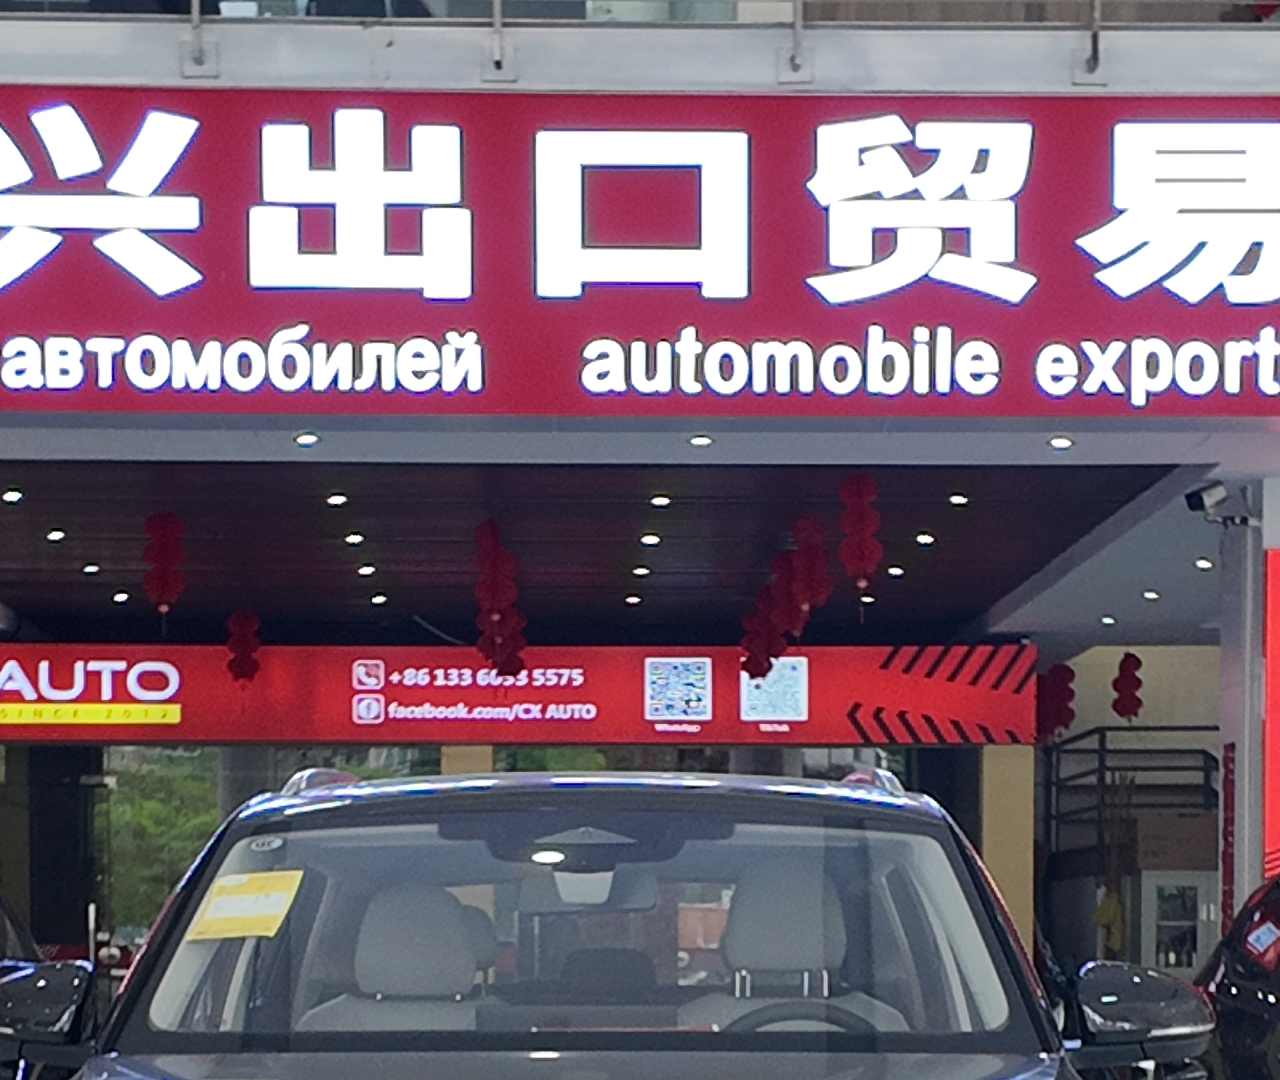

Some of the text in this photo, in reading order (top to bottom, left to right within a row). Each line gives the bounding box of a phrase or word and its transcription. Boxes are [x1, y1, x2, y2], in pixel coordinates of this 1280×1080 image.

[0, 322, 485, 394] автомобилей
[579, 323, 1002, 397] automobile
[388, 667, 431, 687] +86
[433, 668, 473, 687] 133
[531, 668, 585, 687] 5575
[544, 703, 597, 720] AUTO
